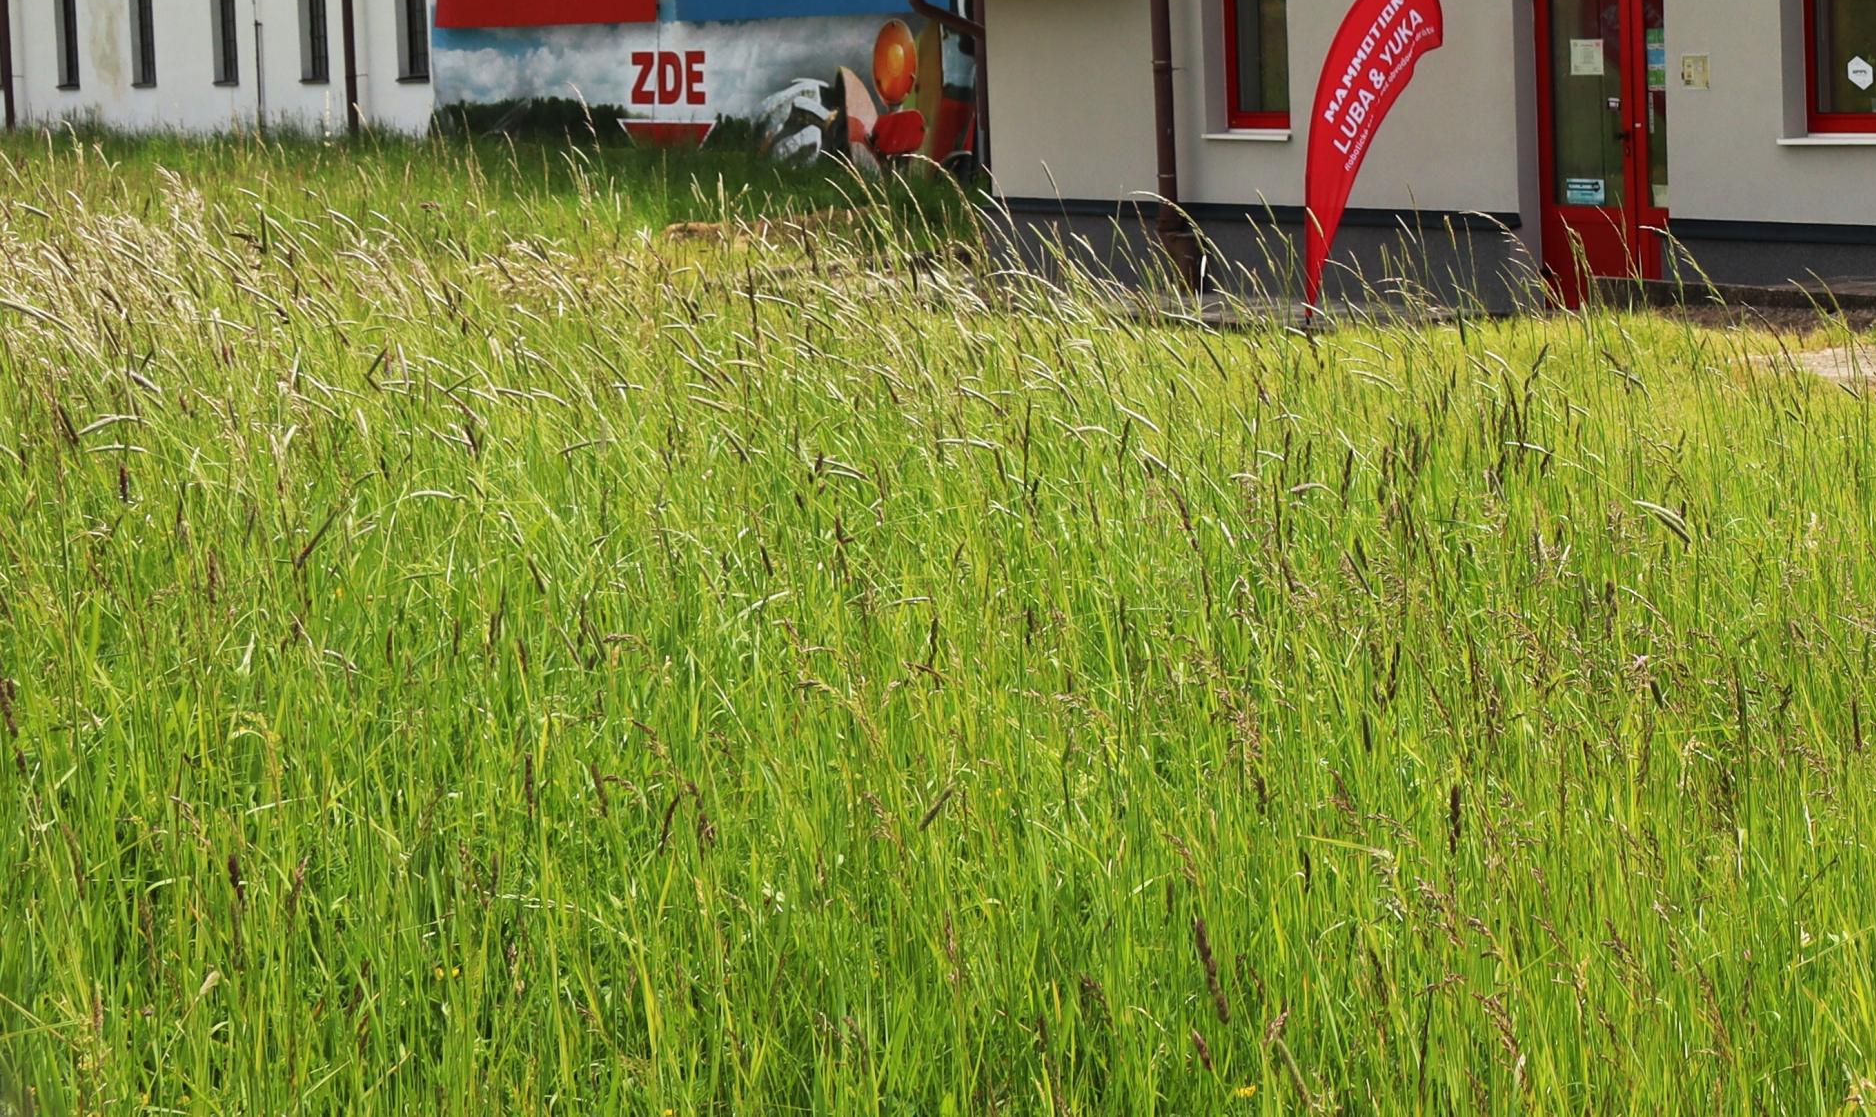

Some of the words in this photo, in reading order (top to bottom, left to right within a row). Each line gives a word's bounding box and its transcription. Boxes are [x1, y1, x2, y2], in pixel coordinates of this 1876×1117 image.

[631, 50, 706, 105] ZDE
[1333, 88, 1376, 155] LUBA
[1368, 67, 1386, 90] &
[1379, 9, 1424, 67] YUKA
